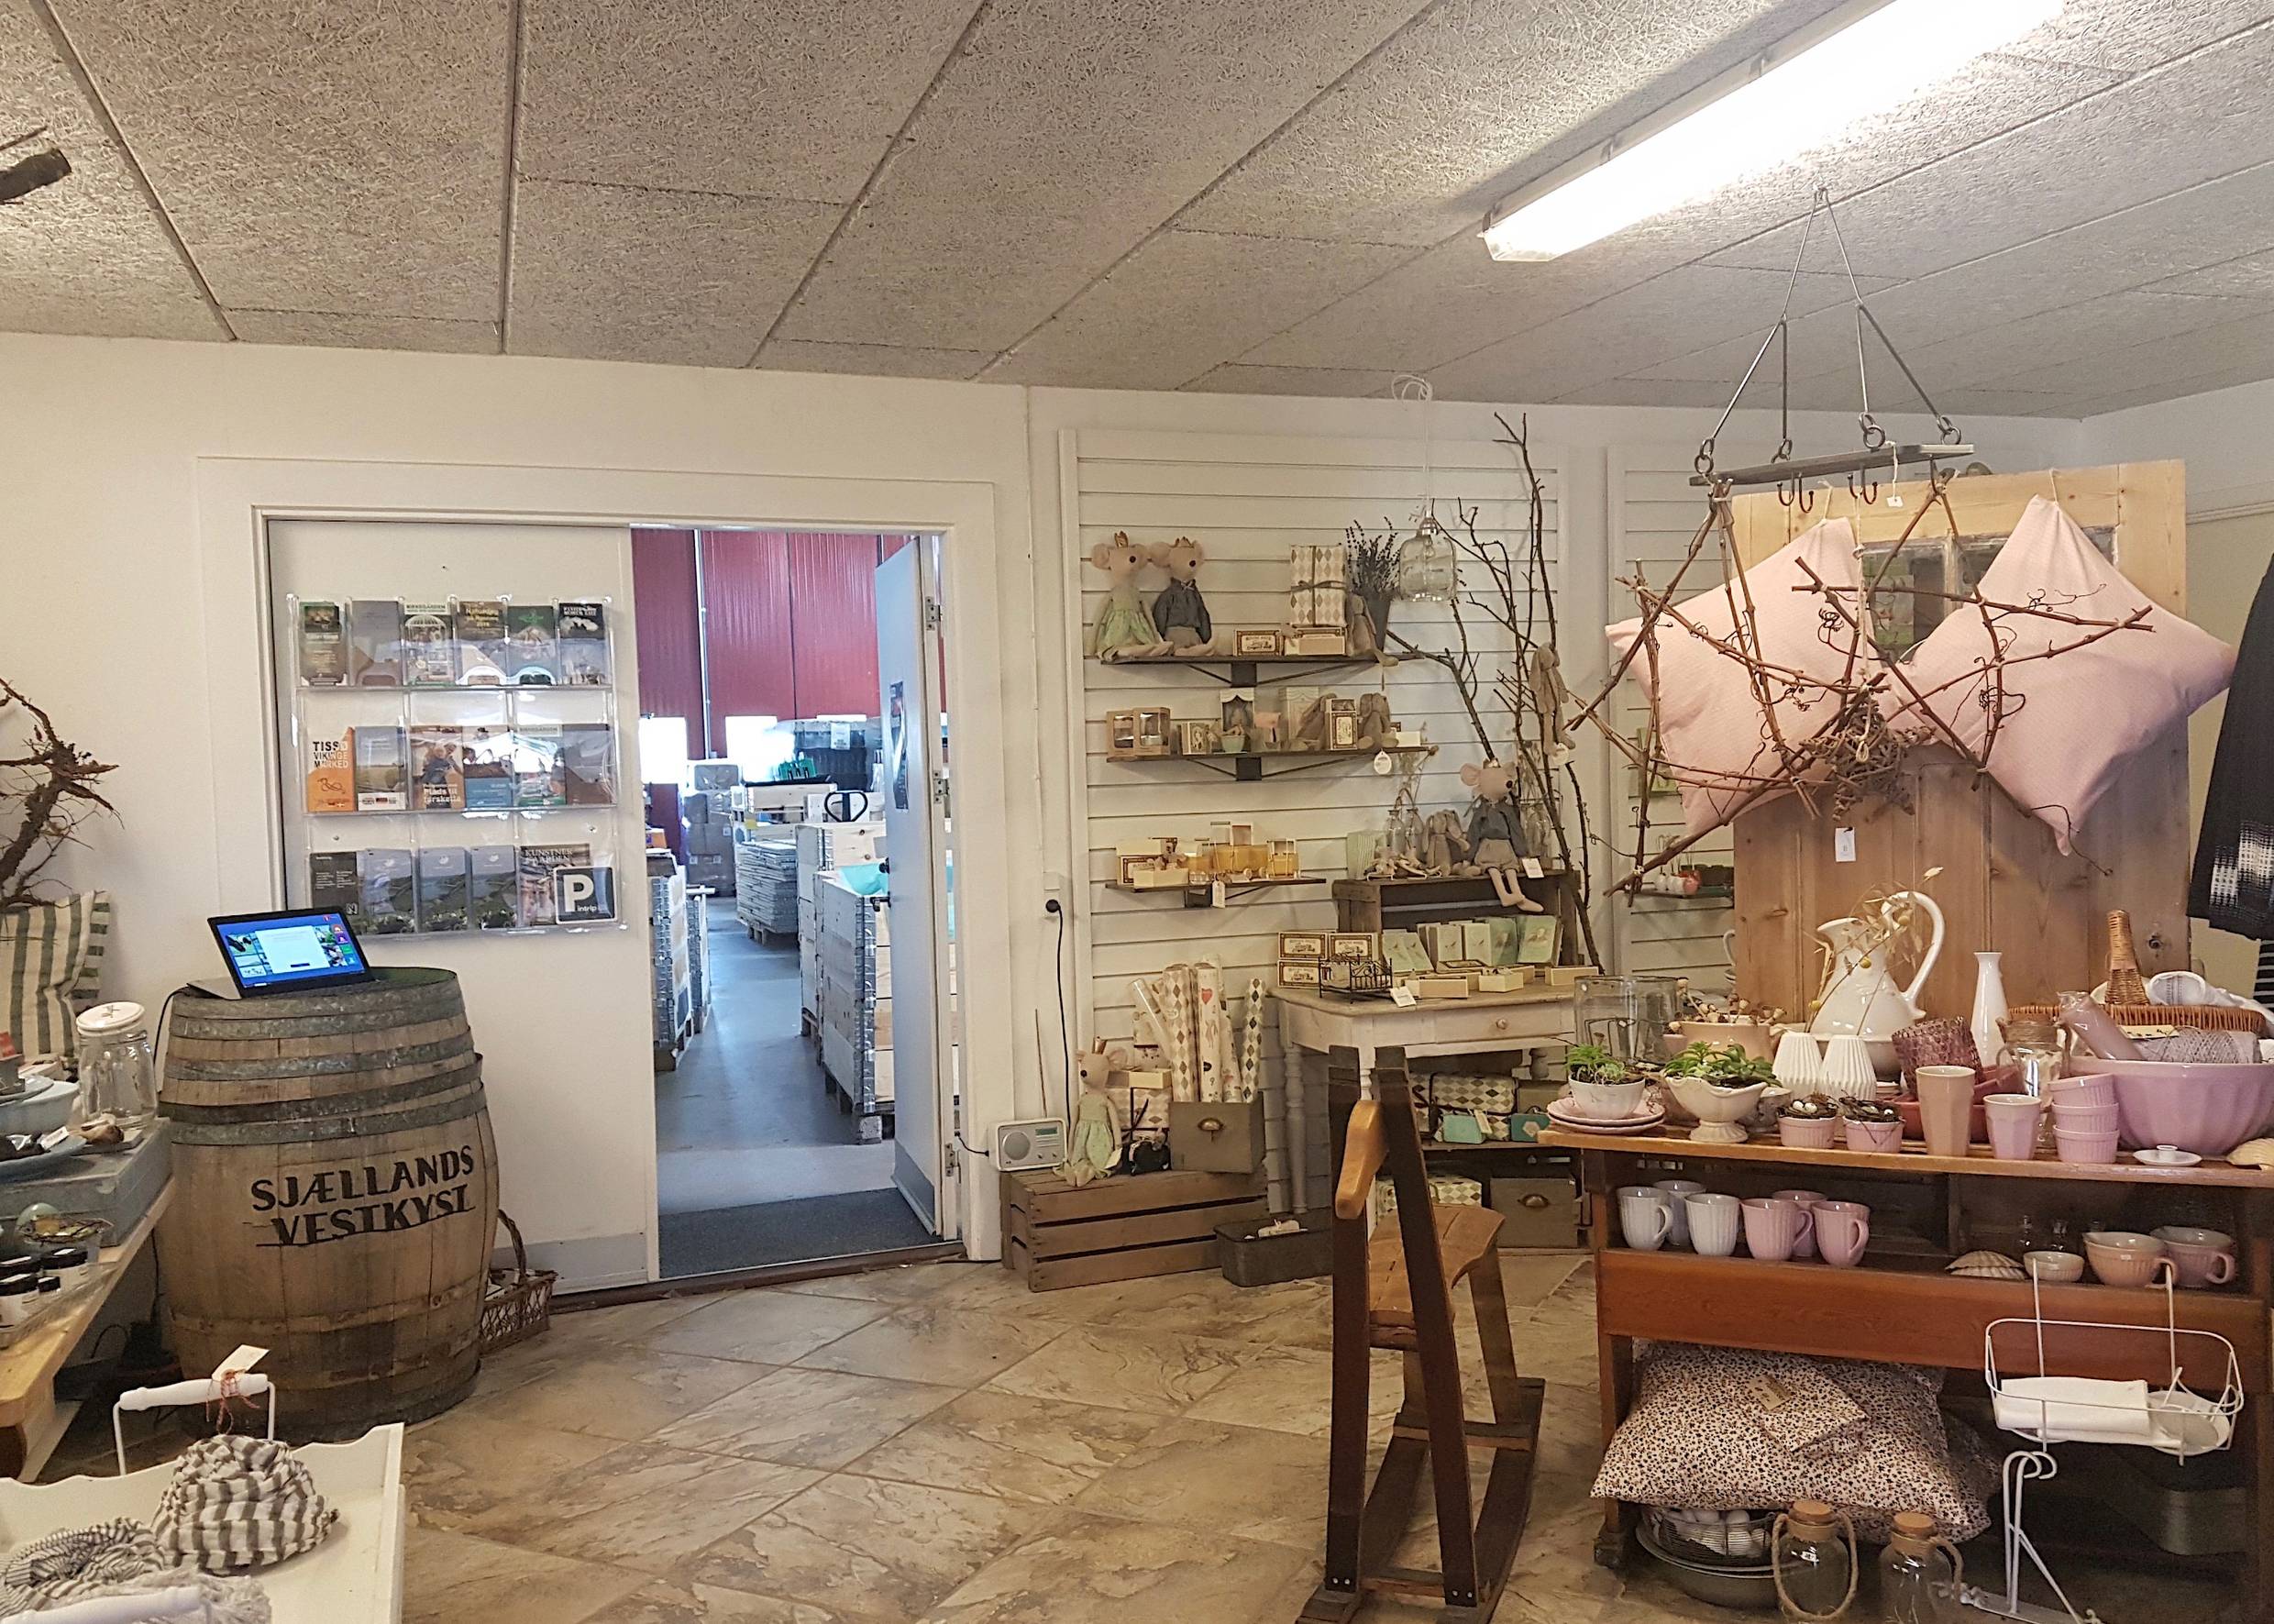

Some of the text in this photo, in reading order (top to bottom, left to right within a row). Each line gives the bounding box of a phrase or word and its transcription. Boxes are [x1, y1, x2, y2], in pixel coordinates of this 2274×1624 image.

[314, 752, 348, 760] VIKINGE
[314, 760, 348, 768] MARKED
[251, 1145, 475, 1211] SJÆLLANDS
[270, 1184, 472, 1246] VESTKYST
